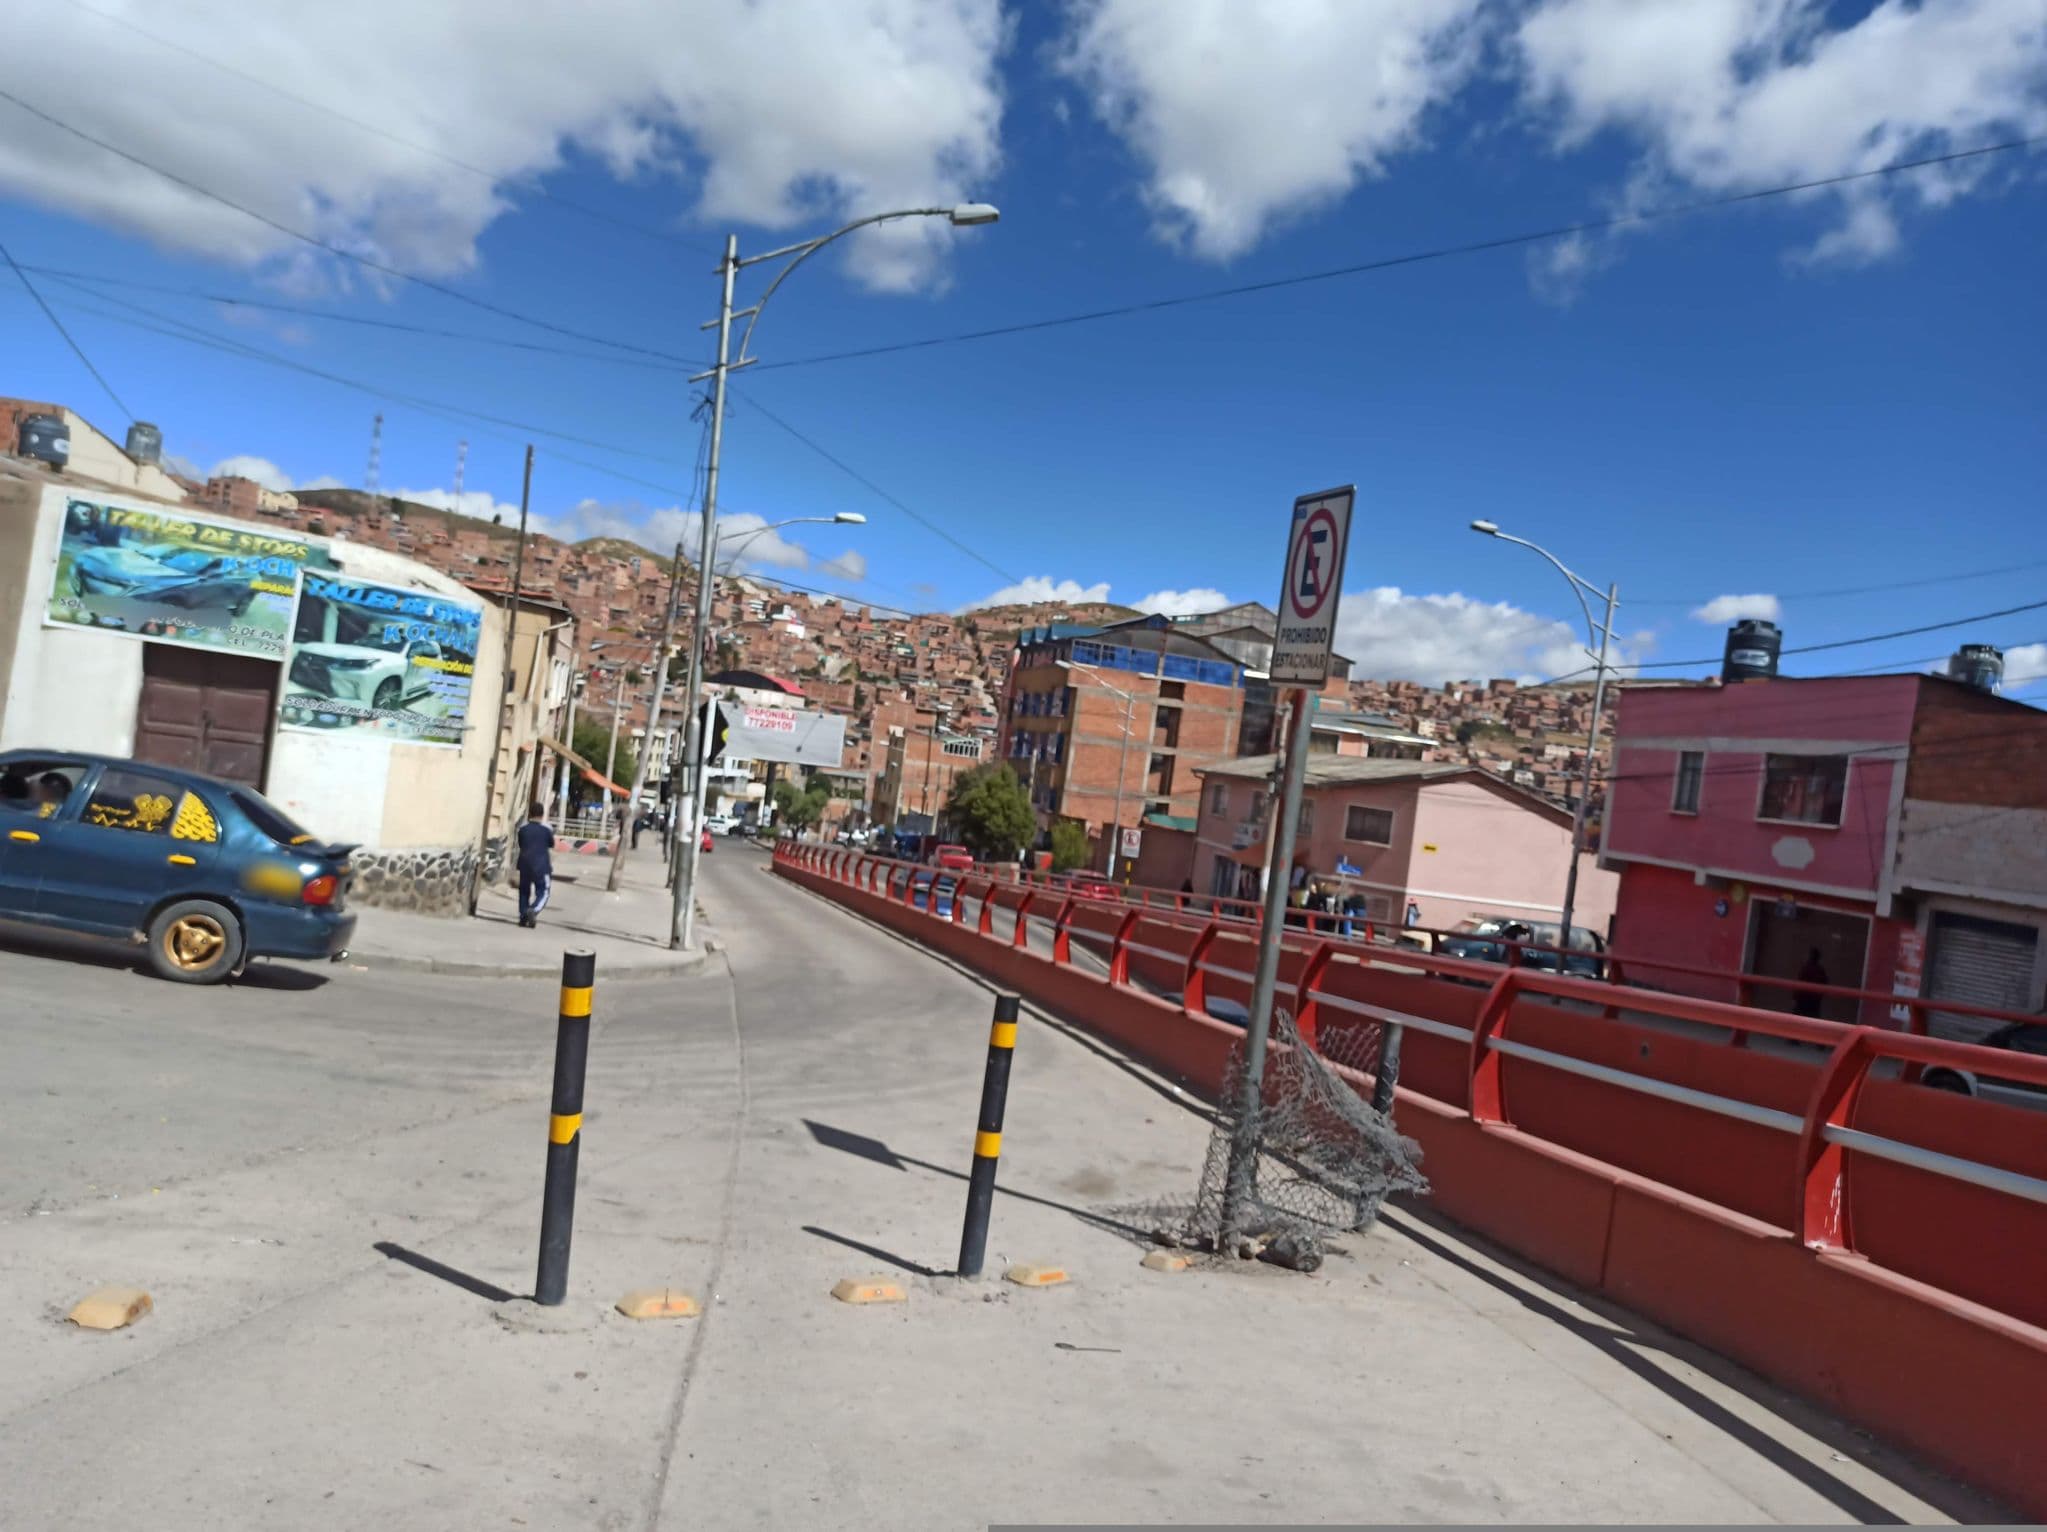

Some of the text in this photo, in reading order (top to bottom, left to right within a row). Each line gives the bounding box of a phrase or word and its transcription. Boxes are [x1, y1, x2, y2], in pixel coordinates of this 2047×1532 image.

[110, 510, 309, 558] TALLER DE STOPS
[308, 579, 398, 609] TALLER
[400, 597, 430, 616] DE
[1280, 626, 1327, 644] PROHIBIDO
[1275, 652, 1326, 669] ESTACIONAR
[745, 706, 798, 721] DISPONIBLE
